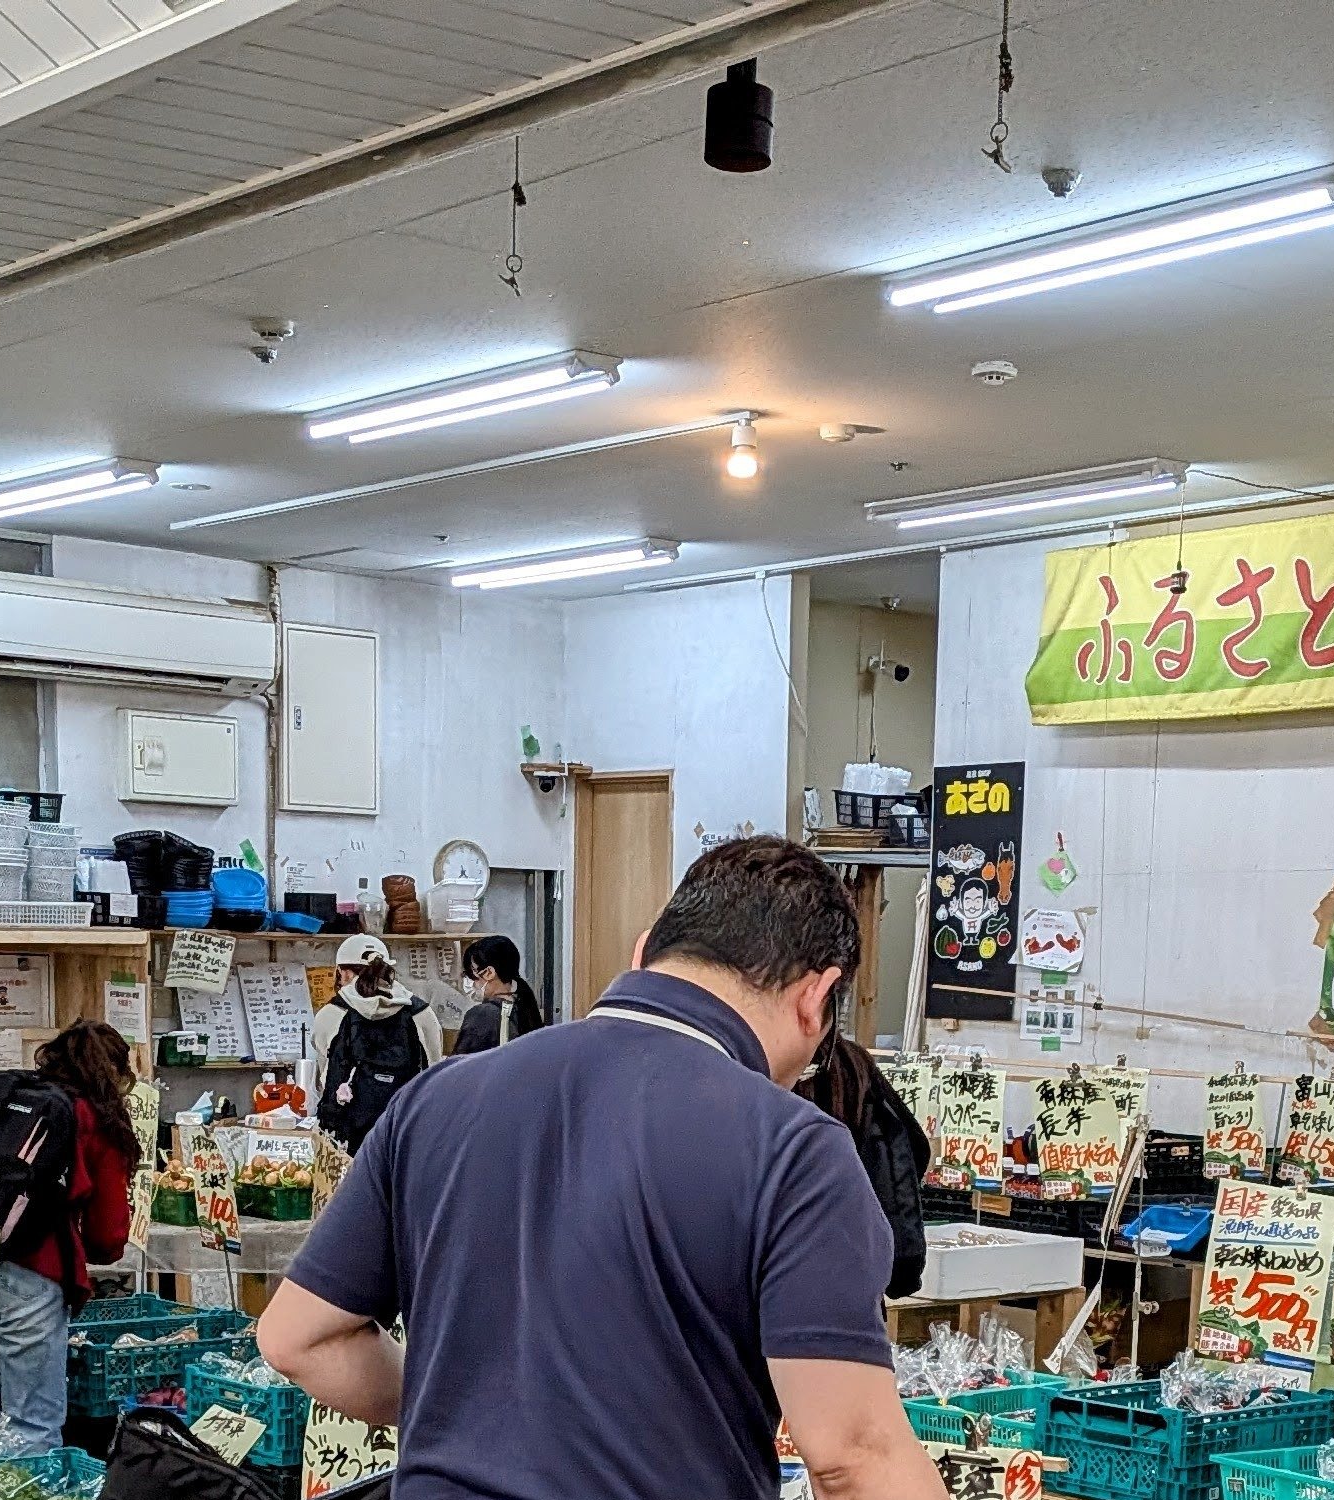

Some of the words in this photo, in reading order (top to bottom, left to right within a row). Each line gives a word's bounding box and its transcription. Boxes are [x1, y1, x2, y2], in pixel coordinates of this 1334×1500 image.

[945, 778, 1010, 815] あさの
[1219, 1187, 1269, 1219] 国産
